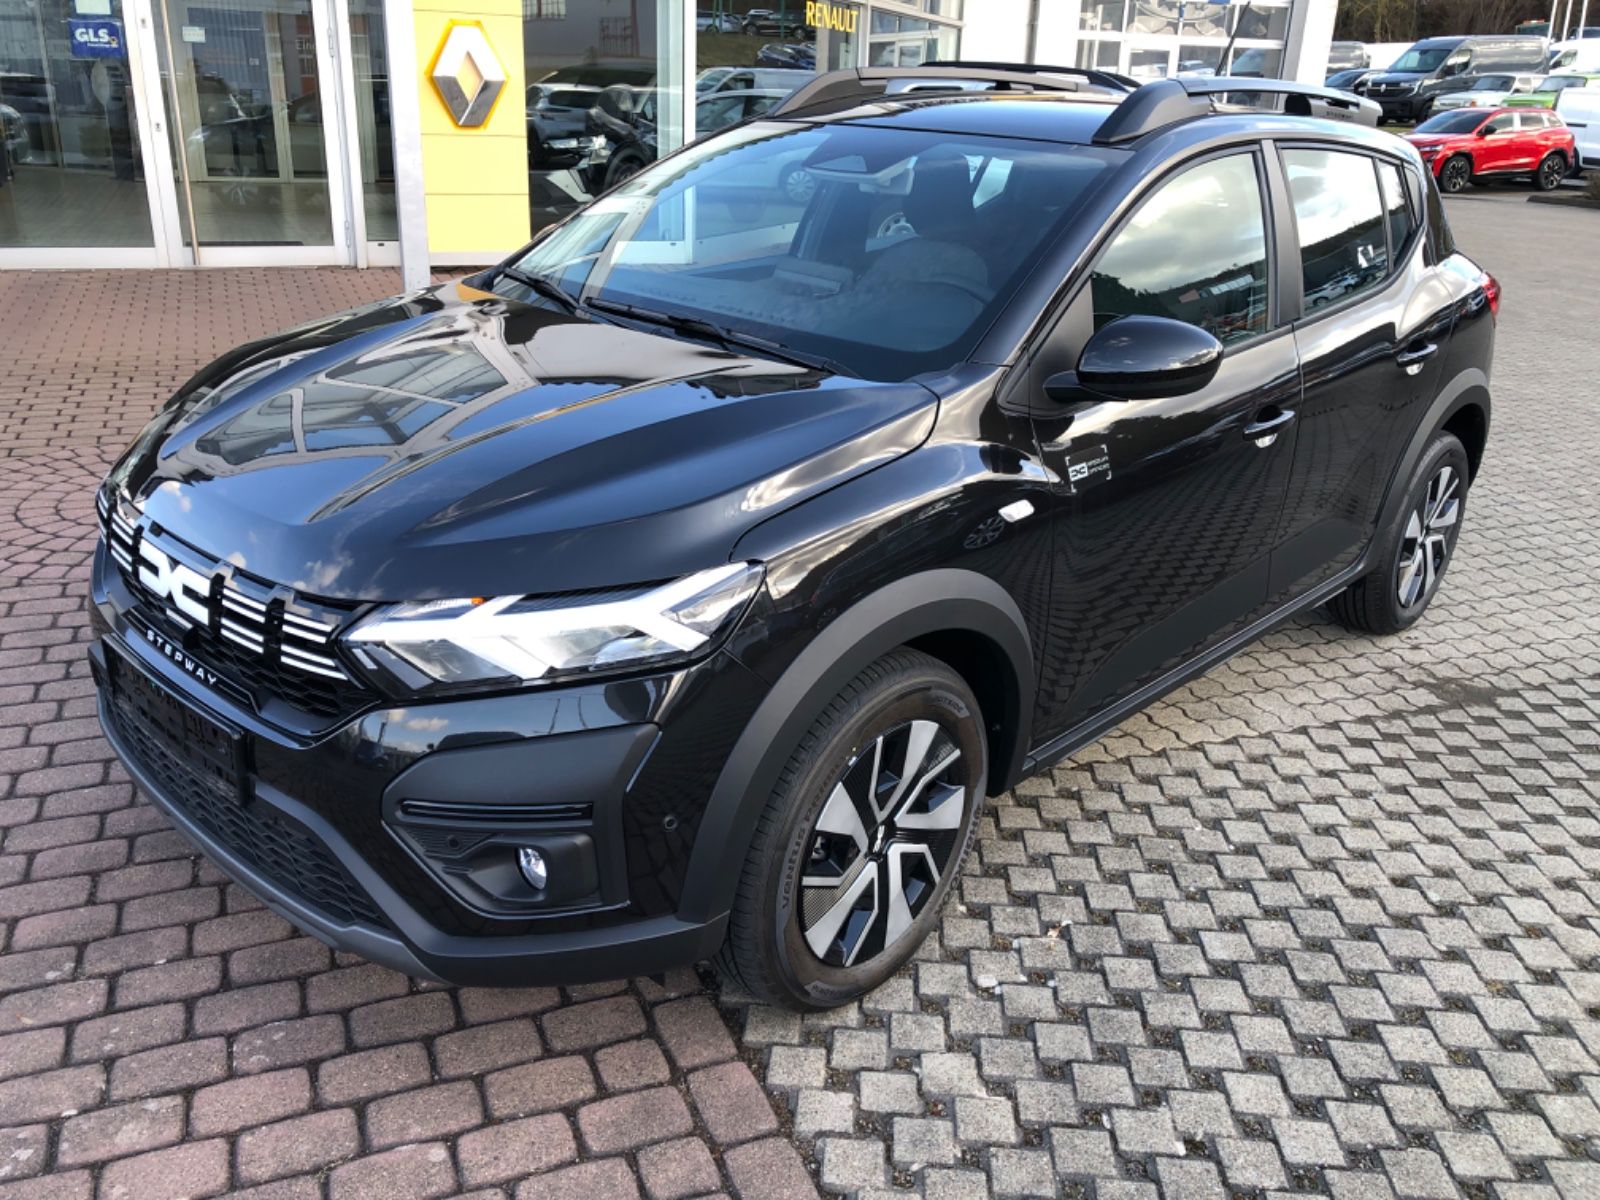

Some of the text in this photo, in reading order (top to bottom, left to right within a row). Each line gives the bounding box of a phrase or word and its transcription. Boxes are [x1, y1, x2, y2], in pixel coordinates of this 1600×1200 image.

[806, 1, 858, 33] RENAULT
[75, 28, 109, 42] GLS
[147, 630, 217, 685] STEPWAY
